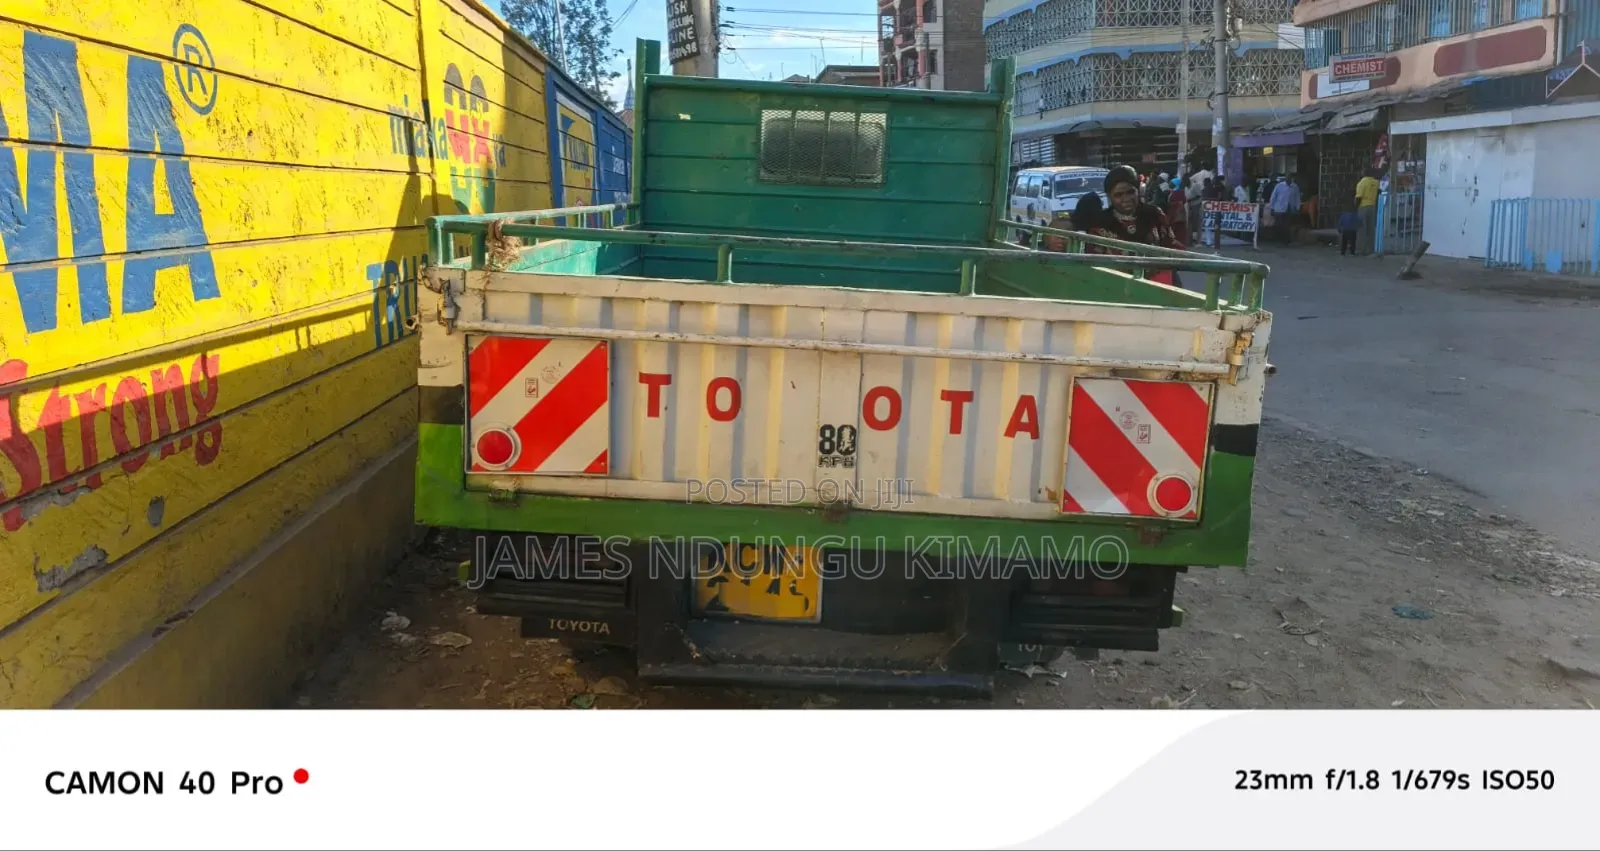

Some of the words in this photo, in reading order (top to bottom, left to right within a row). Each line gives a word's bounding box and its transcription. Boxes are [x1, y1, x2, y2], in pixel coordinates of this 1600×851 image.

[1335, 60, 1384, 75] CHEMIST
[1203, 201, 1256, 213] CHEMIST
[0, 353, 222, 532] Strong
[819, 424, 857, 455] 80
[548, 618, 611, 636] TOYOTA
